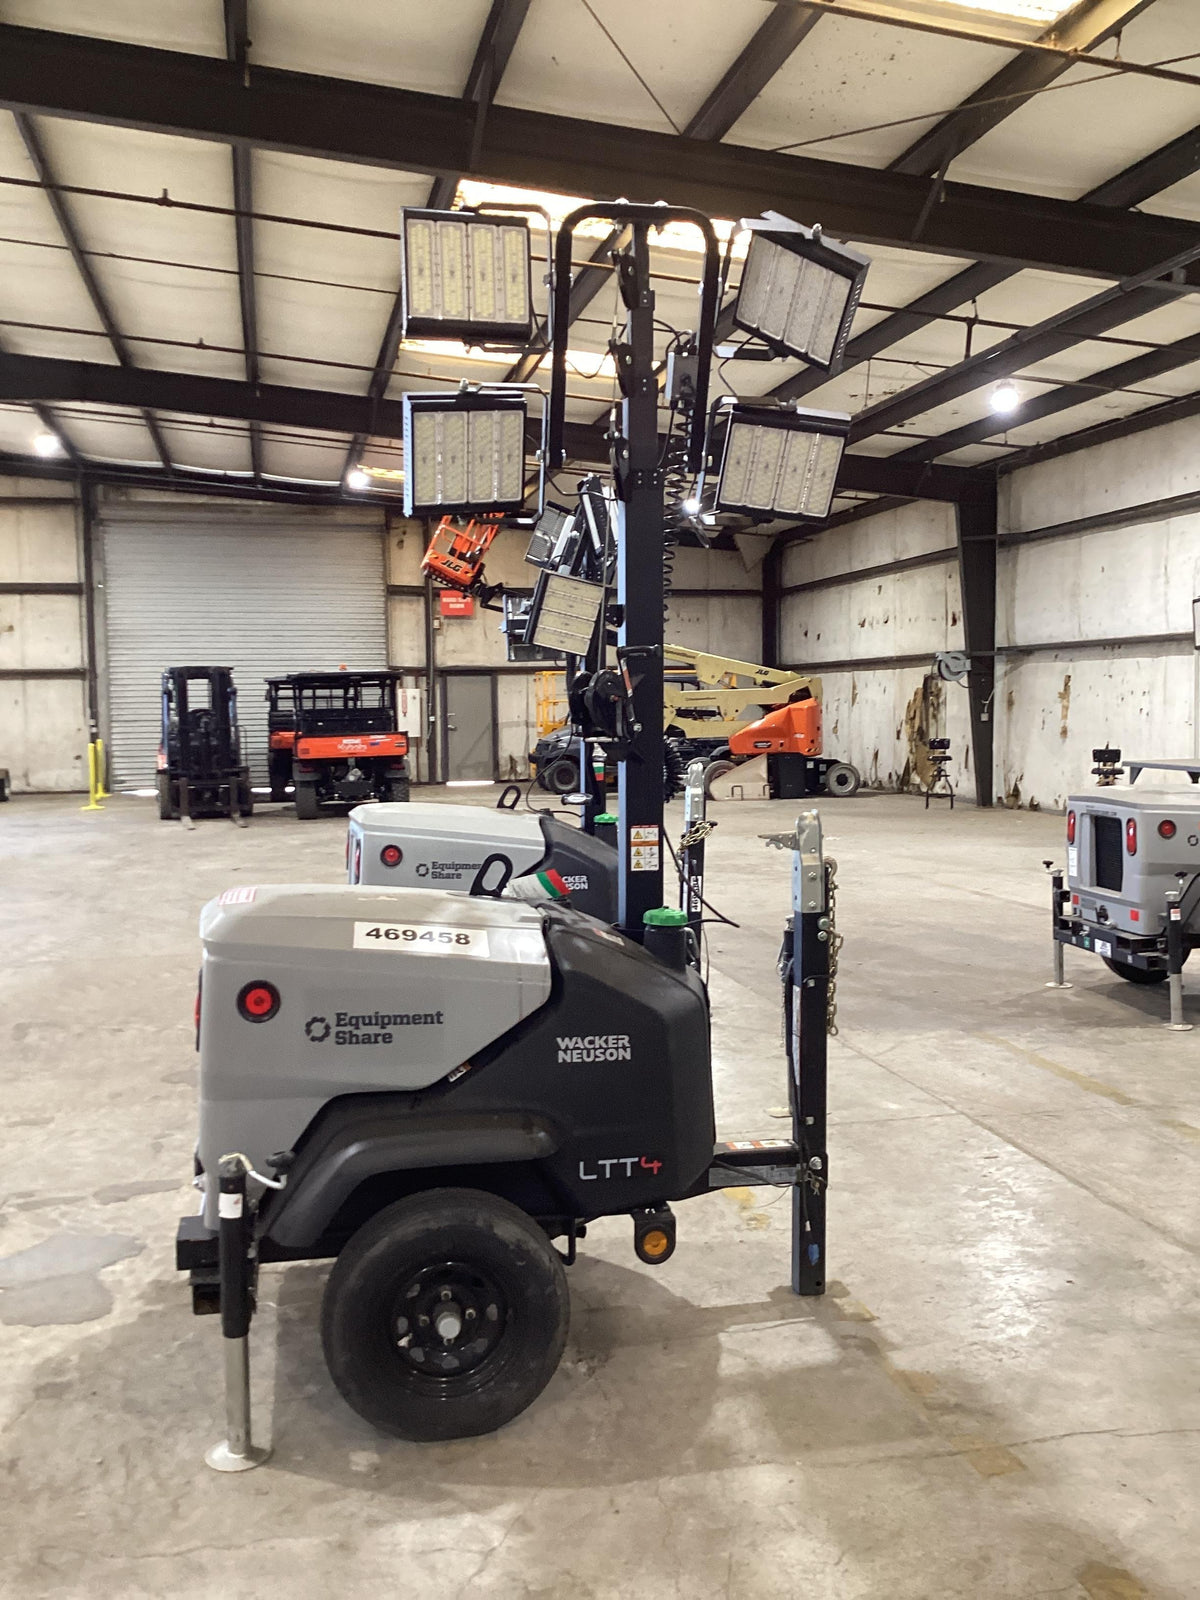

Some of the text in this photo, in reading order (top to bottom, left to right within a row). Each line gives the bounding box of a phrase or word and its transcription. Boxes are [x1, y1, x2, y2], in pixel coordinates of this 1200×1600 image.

[442, 560, 462, 572] JLG
[431, 861, 481, 872] Equipmen
[431, 871, 462, 880] Share
[562, 875, 588, 883] CKER
[566, 882, 589, 890] SON
[366, 928, 471, 945] 469458
[335, 1011, 443, 1029] Equipment
[335, 1030, 393, 1045] Share
[556, 1035, 631, 1050] WACKER
[558, 1048, 632, 1063] NEUSON
[579, 1156, 662, 1180] LTT4
